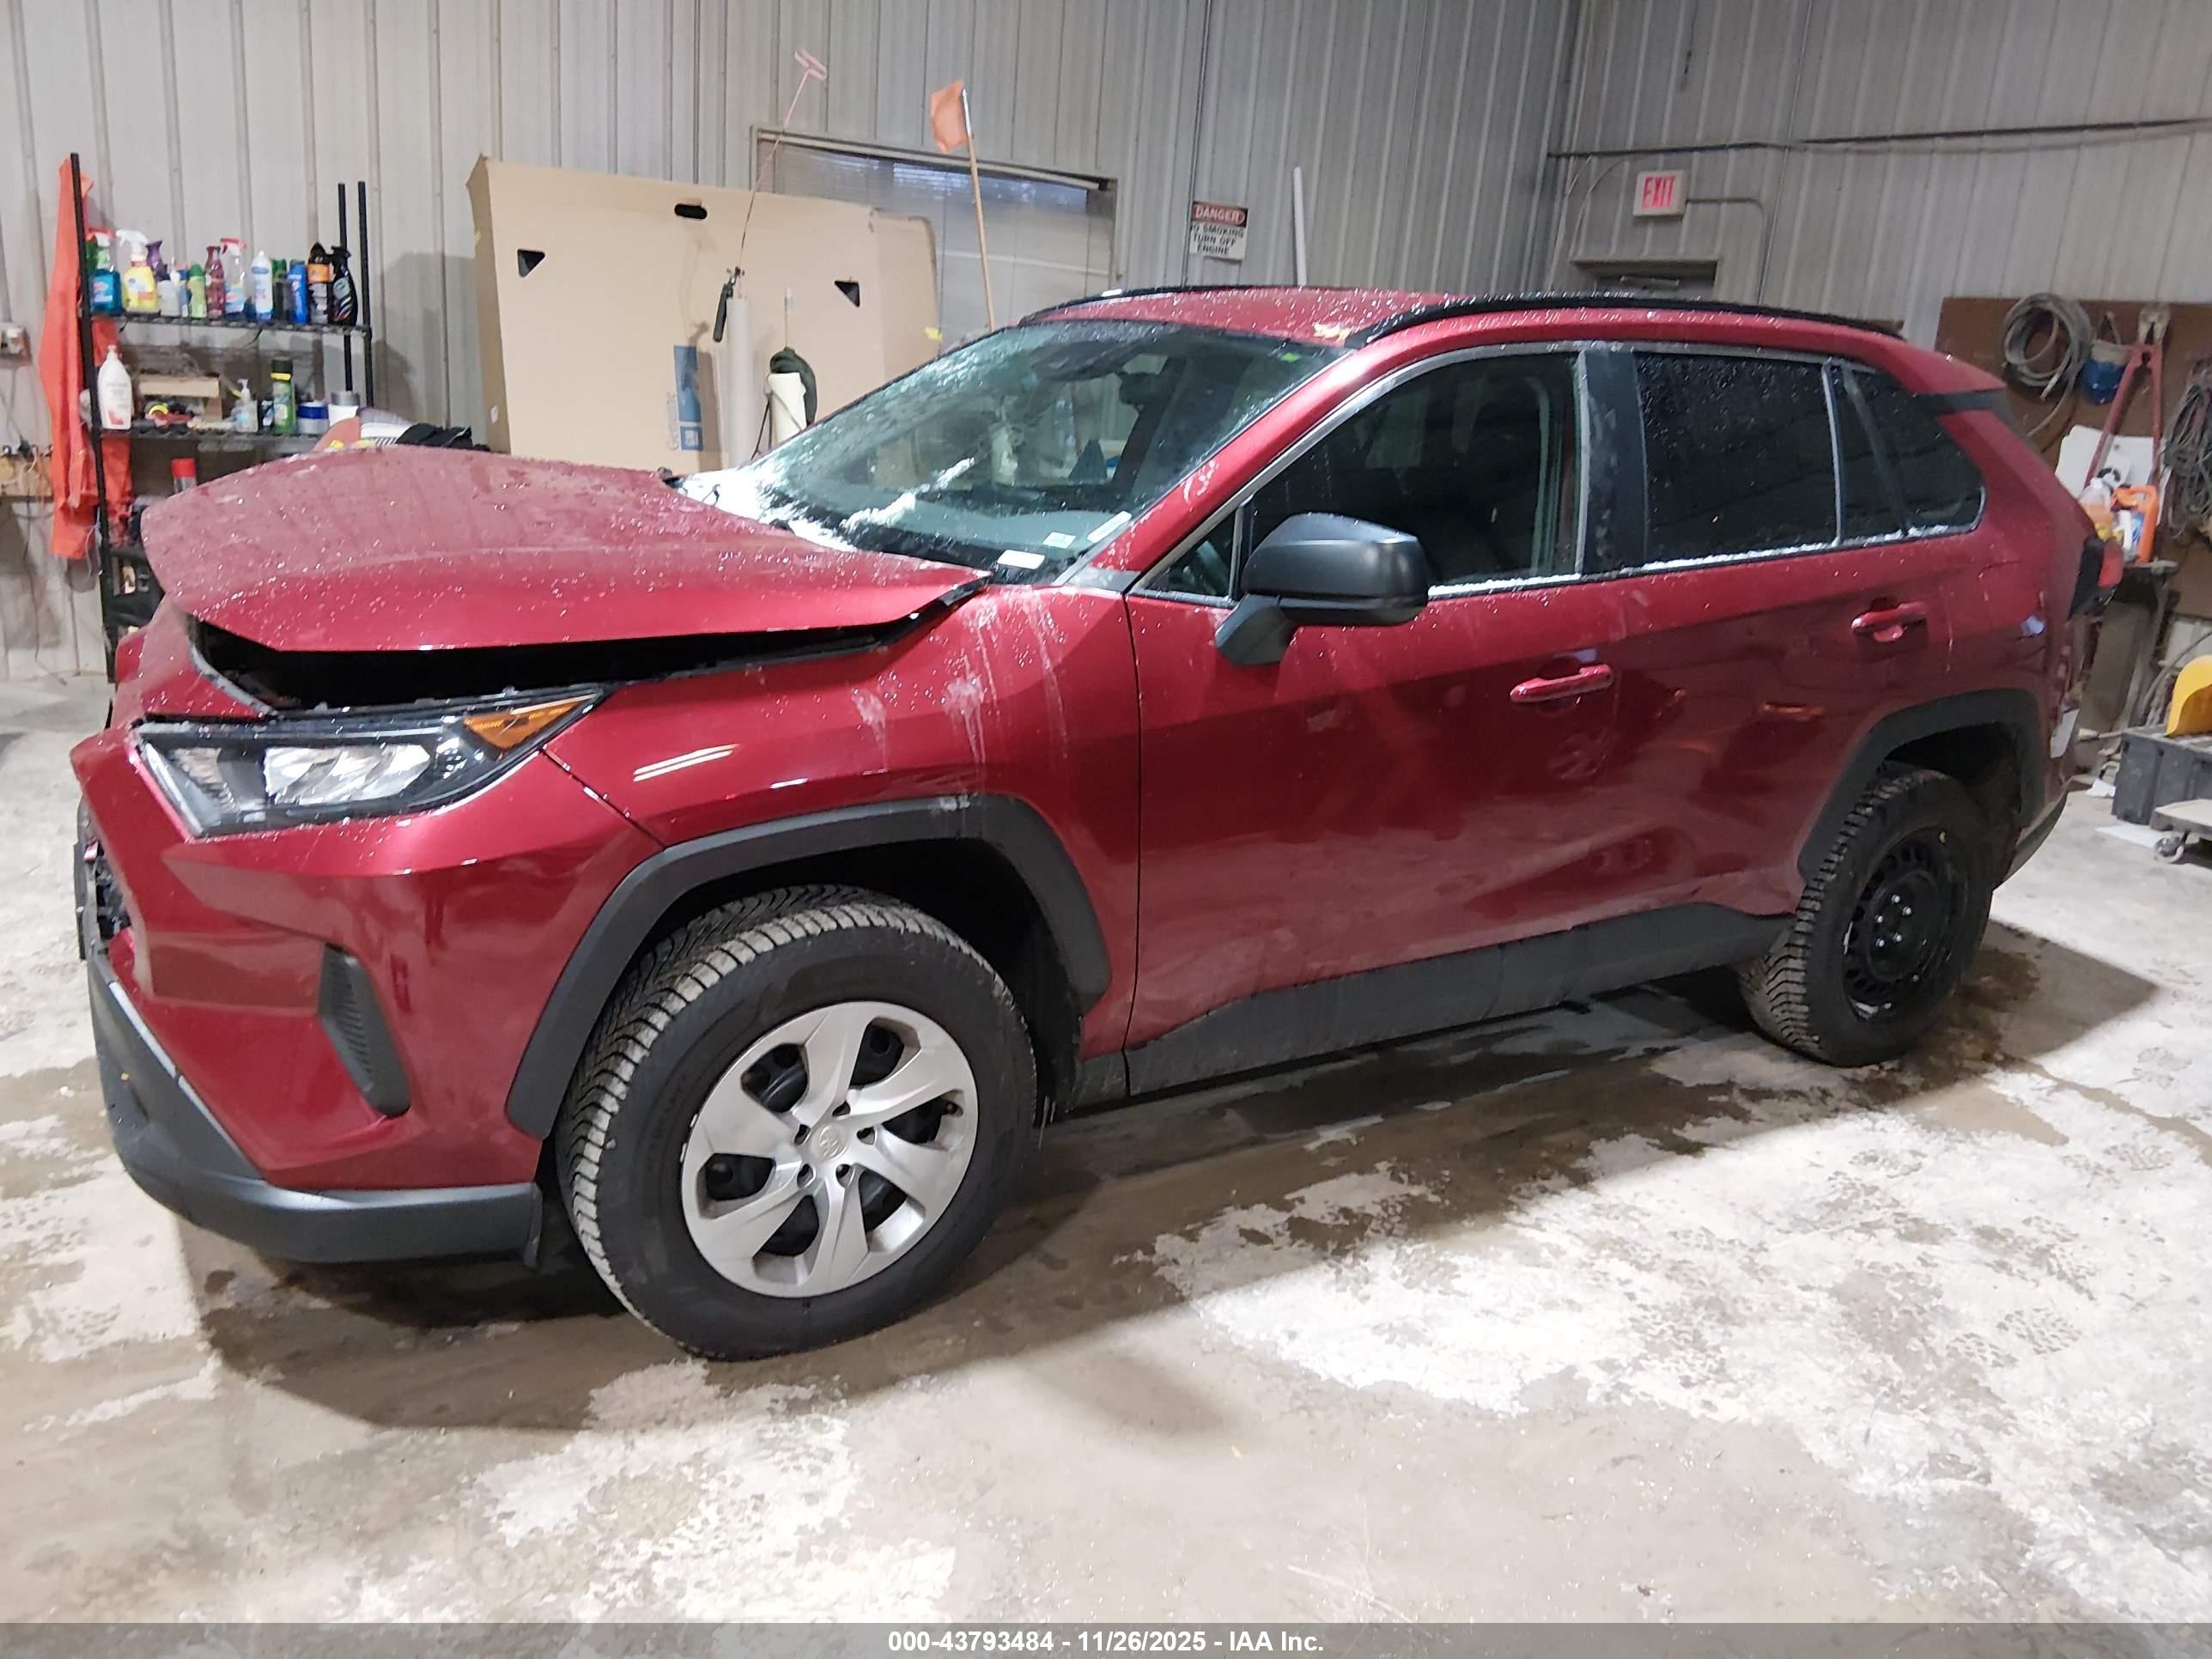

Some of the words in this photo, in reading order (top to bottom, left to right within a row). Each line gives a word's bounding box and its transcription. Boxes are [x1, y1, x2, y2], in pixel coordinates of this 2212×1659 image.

[1641, 174, 1677, 208] EXIT
[1194, 205, 1240, 222] DANGER
[1203, 225, 1244, 238] SMOKING
[1194, 234, 1217, 244] TURN
[1219, 237, 1237, 246] OFF
[1197, 244, 1230, 254] ENGINE
